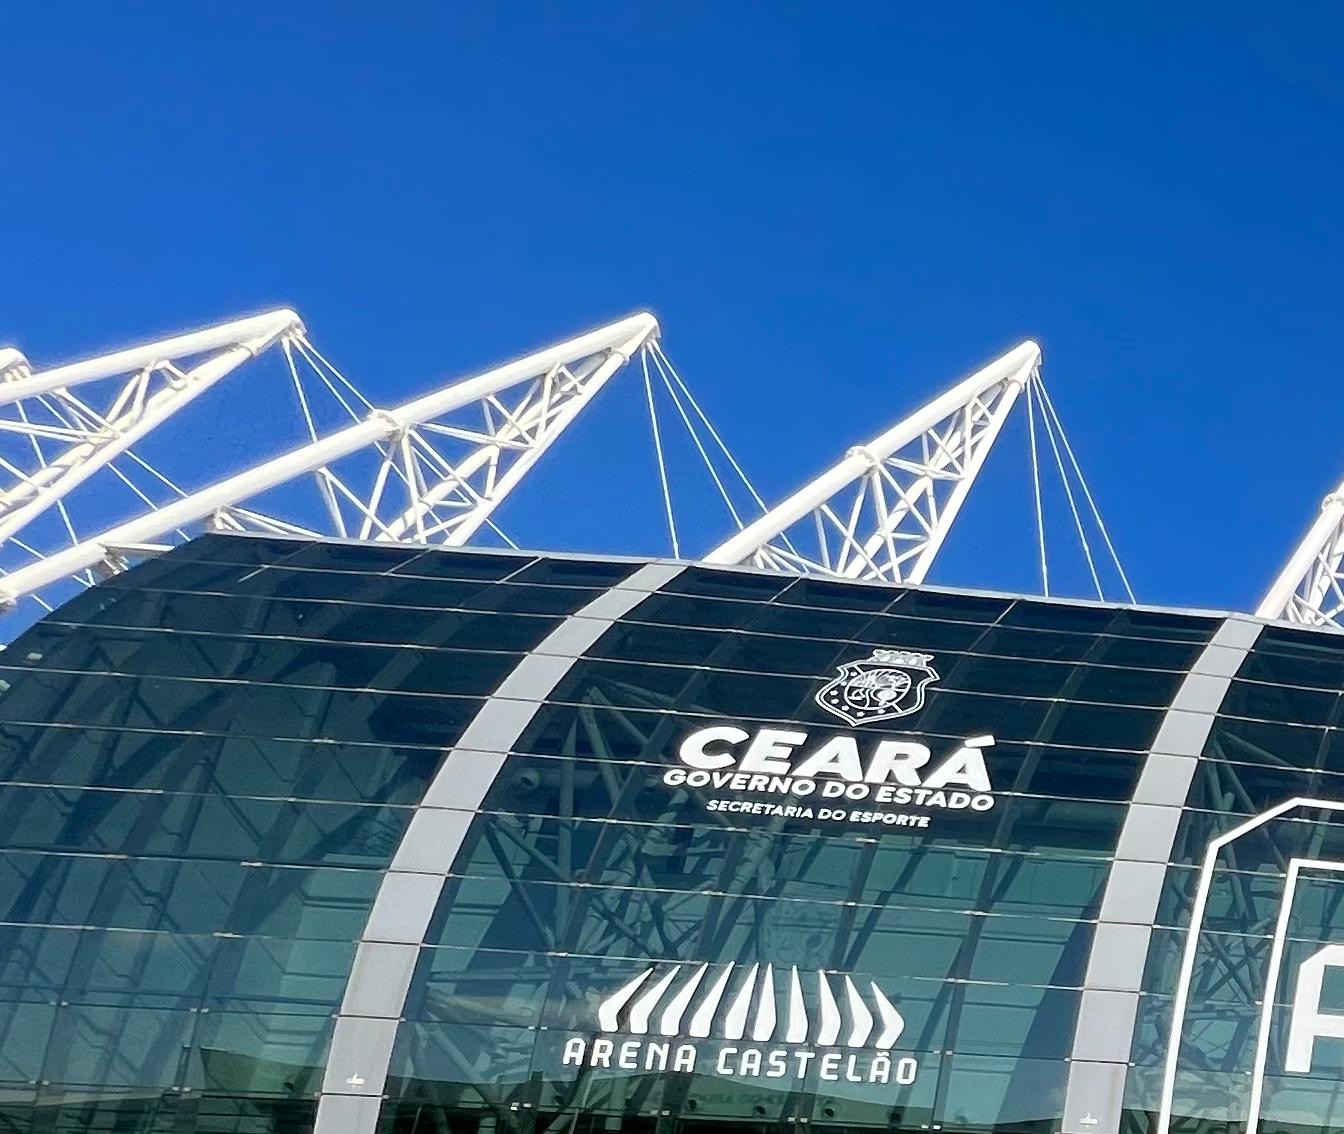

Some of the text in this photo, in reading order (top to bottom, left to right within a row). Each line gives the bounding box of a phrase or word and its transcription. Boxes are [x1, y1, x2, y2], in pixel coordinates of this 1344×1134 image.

[679, 726, 996, 791] CEARÁ
[662, 769, 996, 811] GOVERNO DO ESTADO
[706, 800, 931, 829] SECRETARIA DO ESPORTE
[562, 1037, 918, 1086] ARENA CASTELÃO
